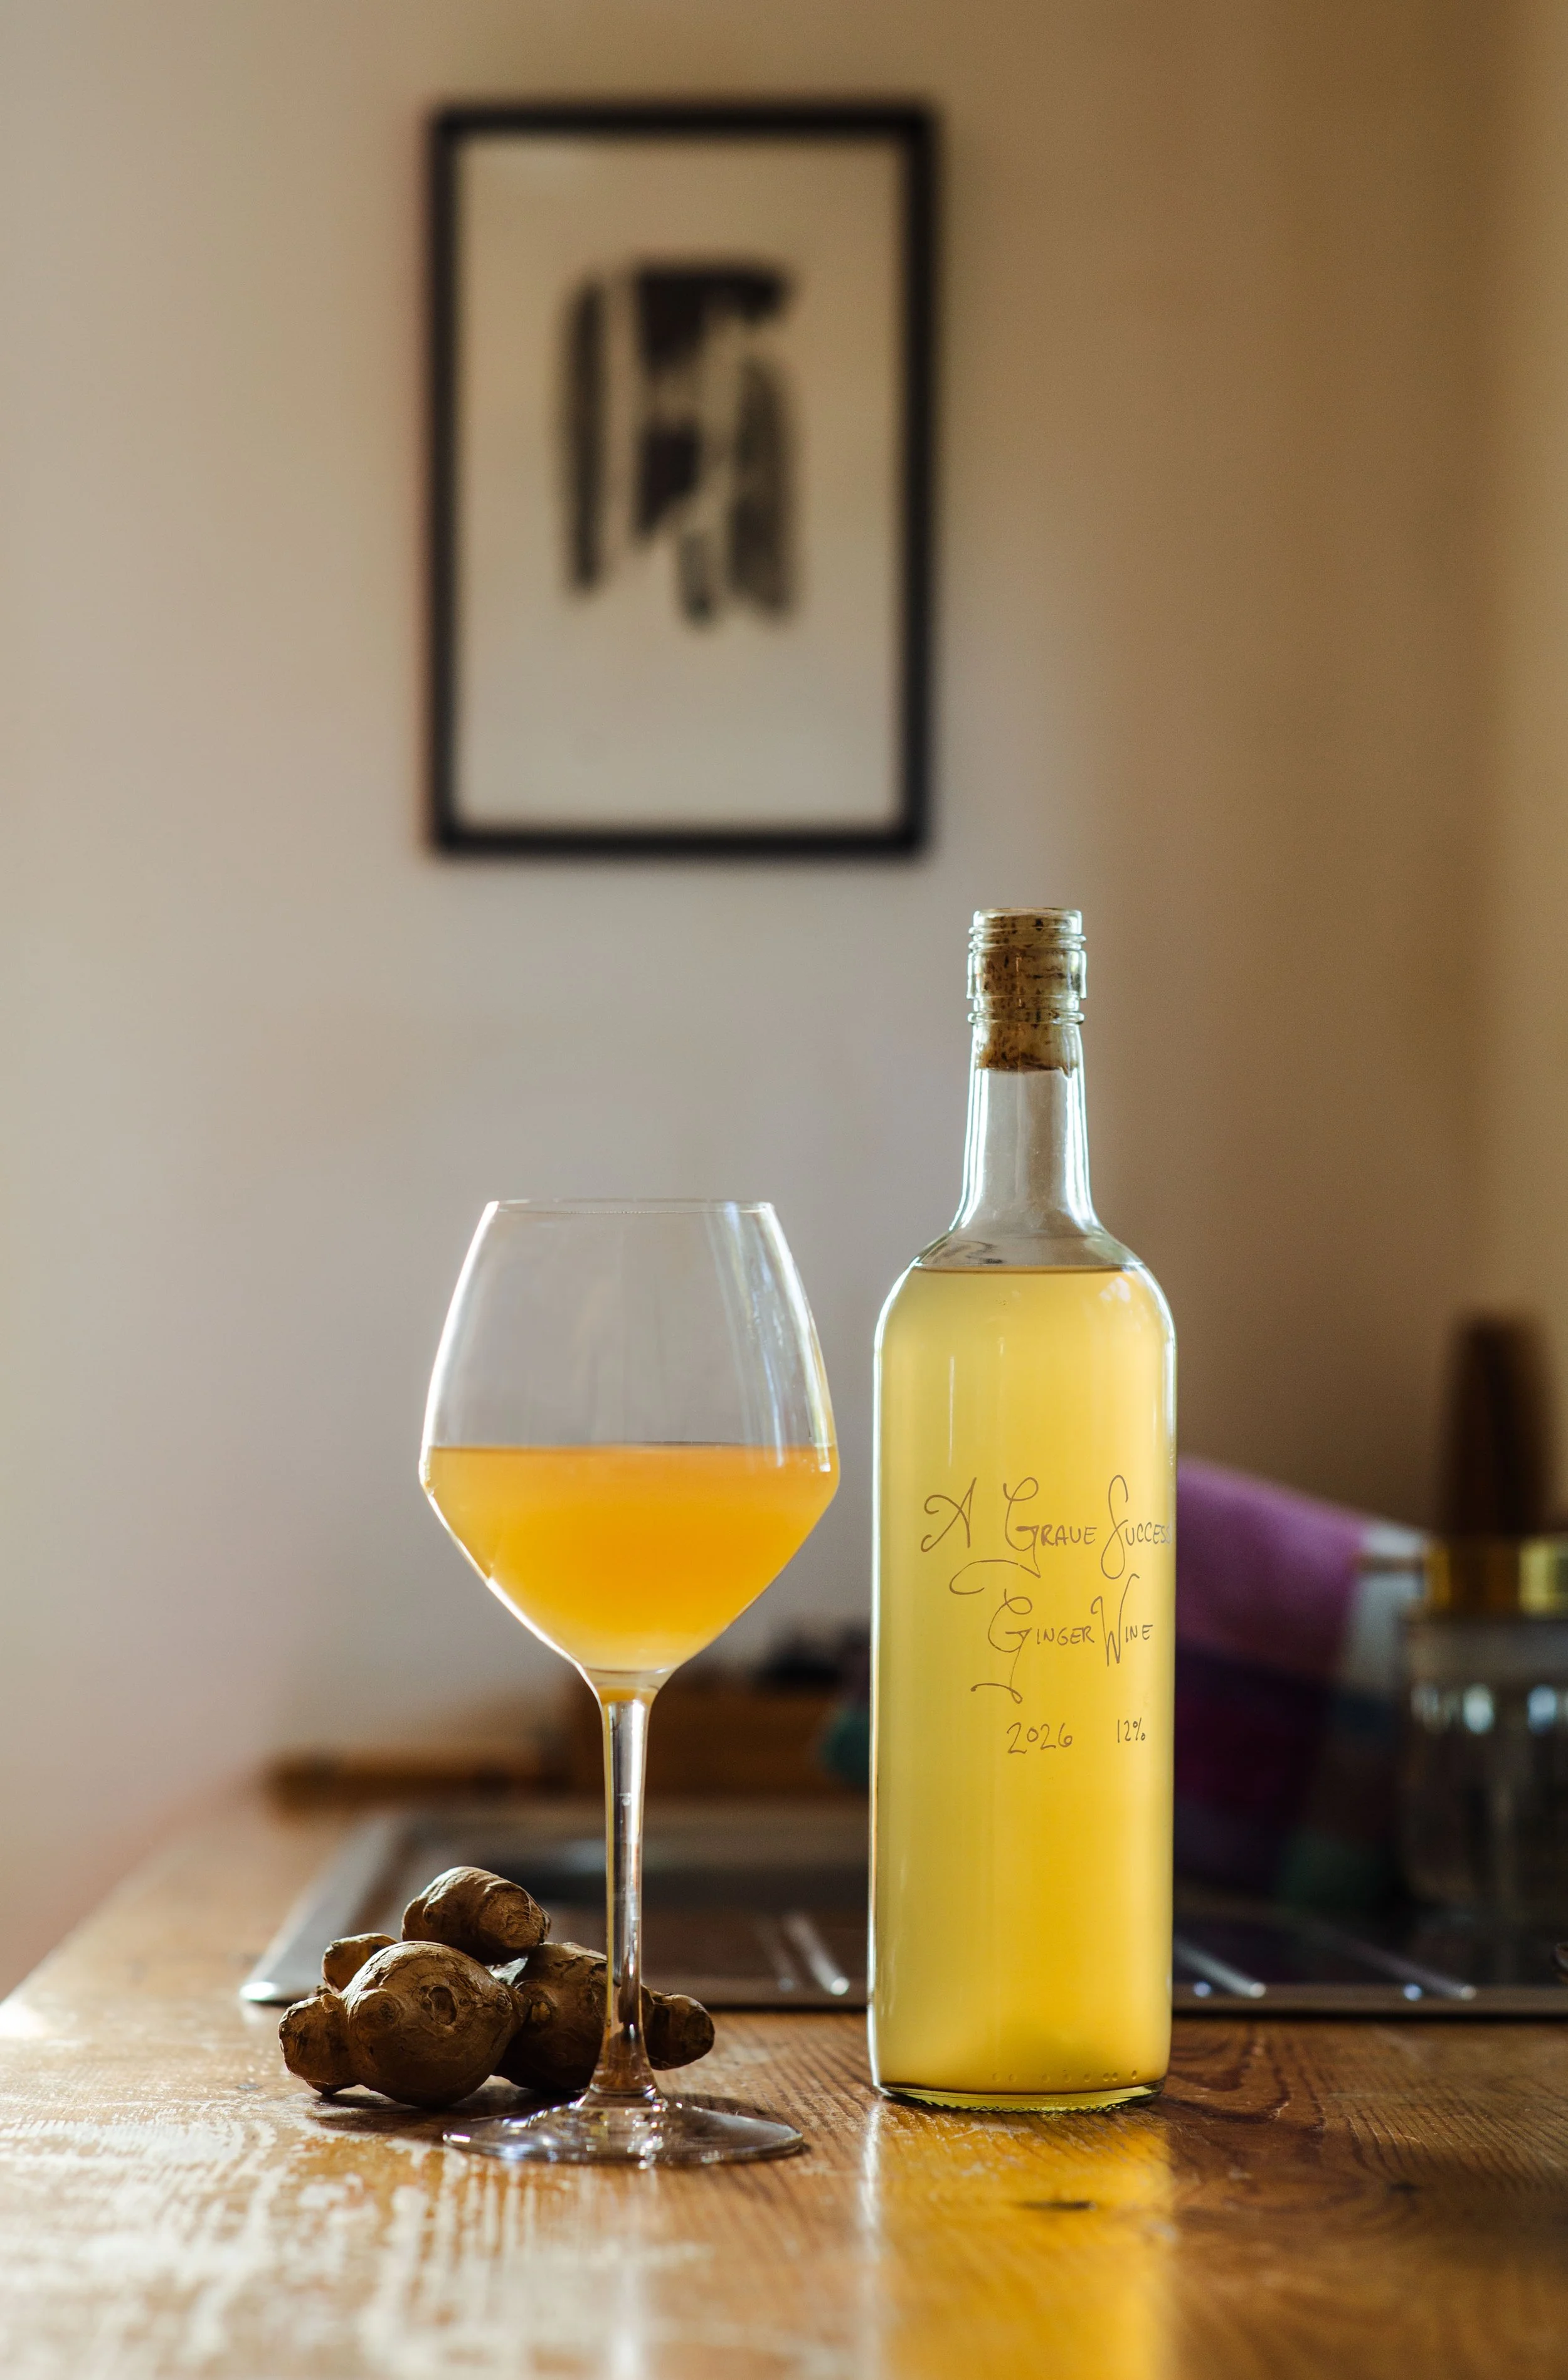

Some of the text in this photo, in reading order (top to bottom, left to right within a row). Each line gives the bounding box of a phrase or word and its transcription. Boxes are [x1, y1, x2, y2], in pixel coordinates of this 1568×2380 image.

[921, 1478, 977, 1552] A
[971, 1573, 1153, 1703] GINGER WINE
[1007, 1718, 1146, 1754] 2026 12%
